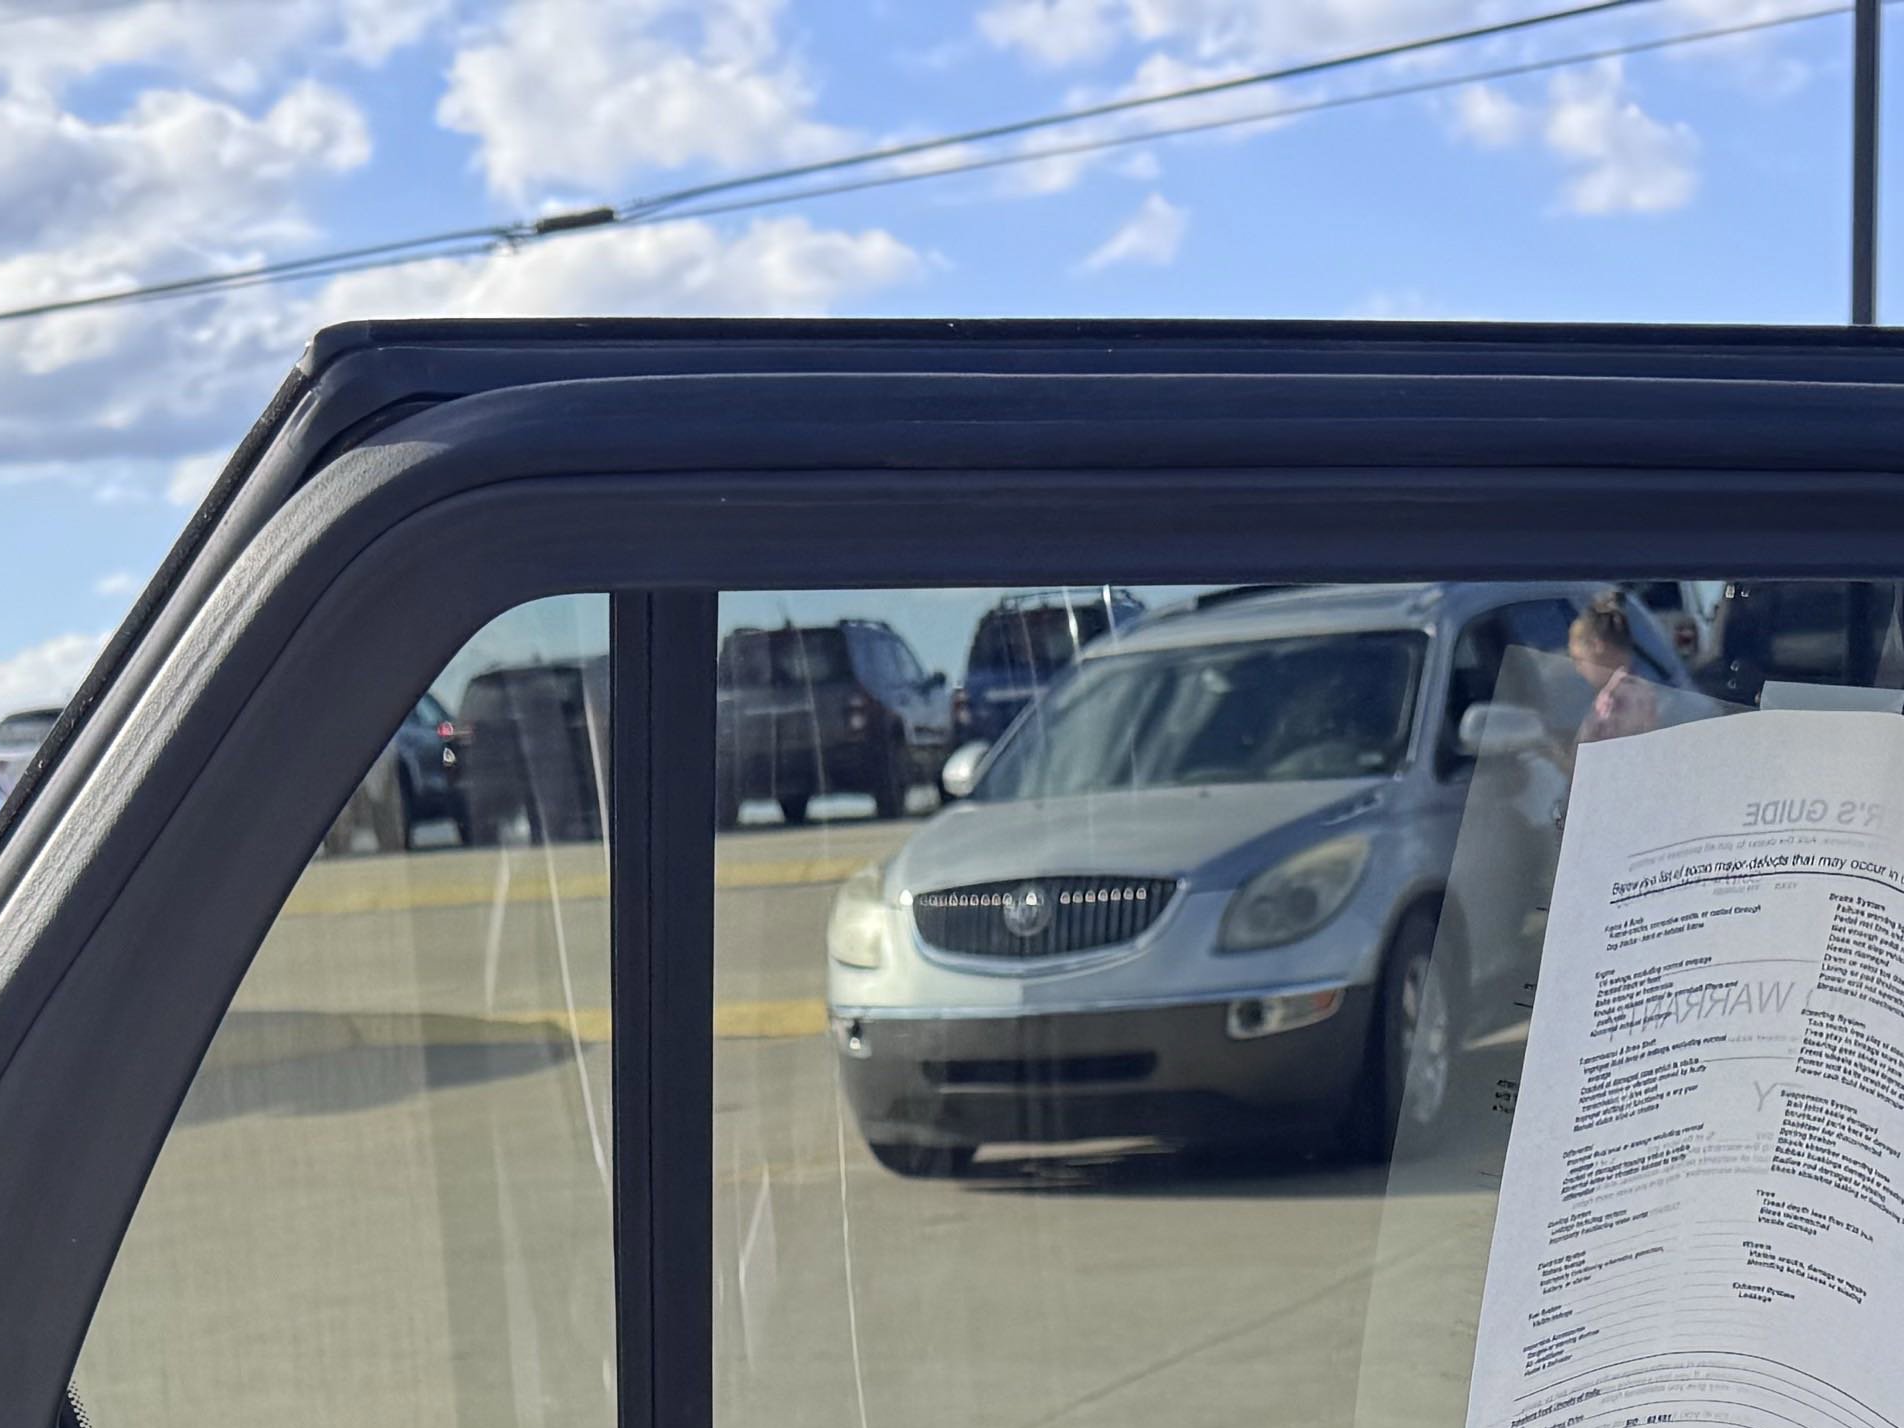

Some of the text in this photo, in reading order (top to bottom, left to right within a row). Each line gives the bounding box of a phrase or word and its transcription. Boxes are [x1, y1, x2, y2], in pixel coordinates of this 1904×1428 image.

[1818, 857, 1847, 869] may
[1850, 860, 1887, 875] occur
[1889, 870, 1899, 881] in
